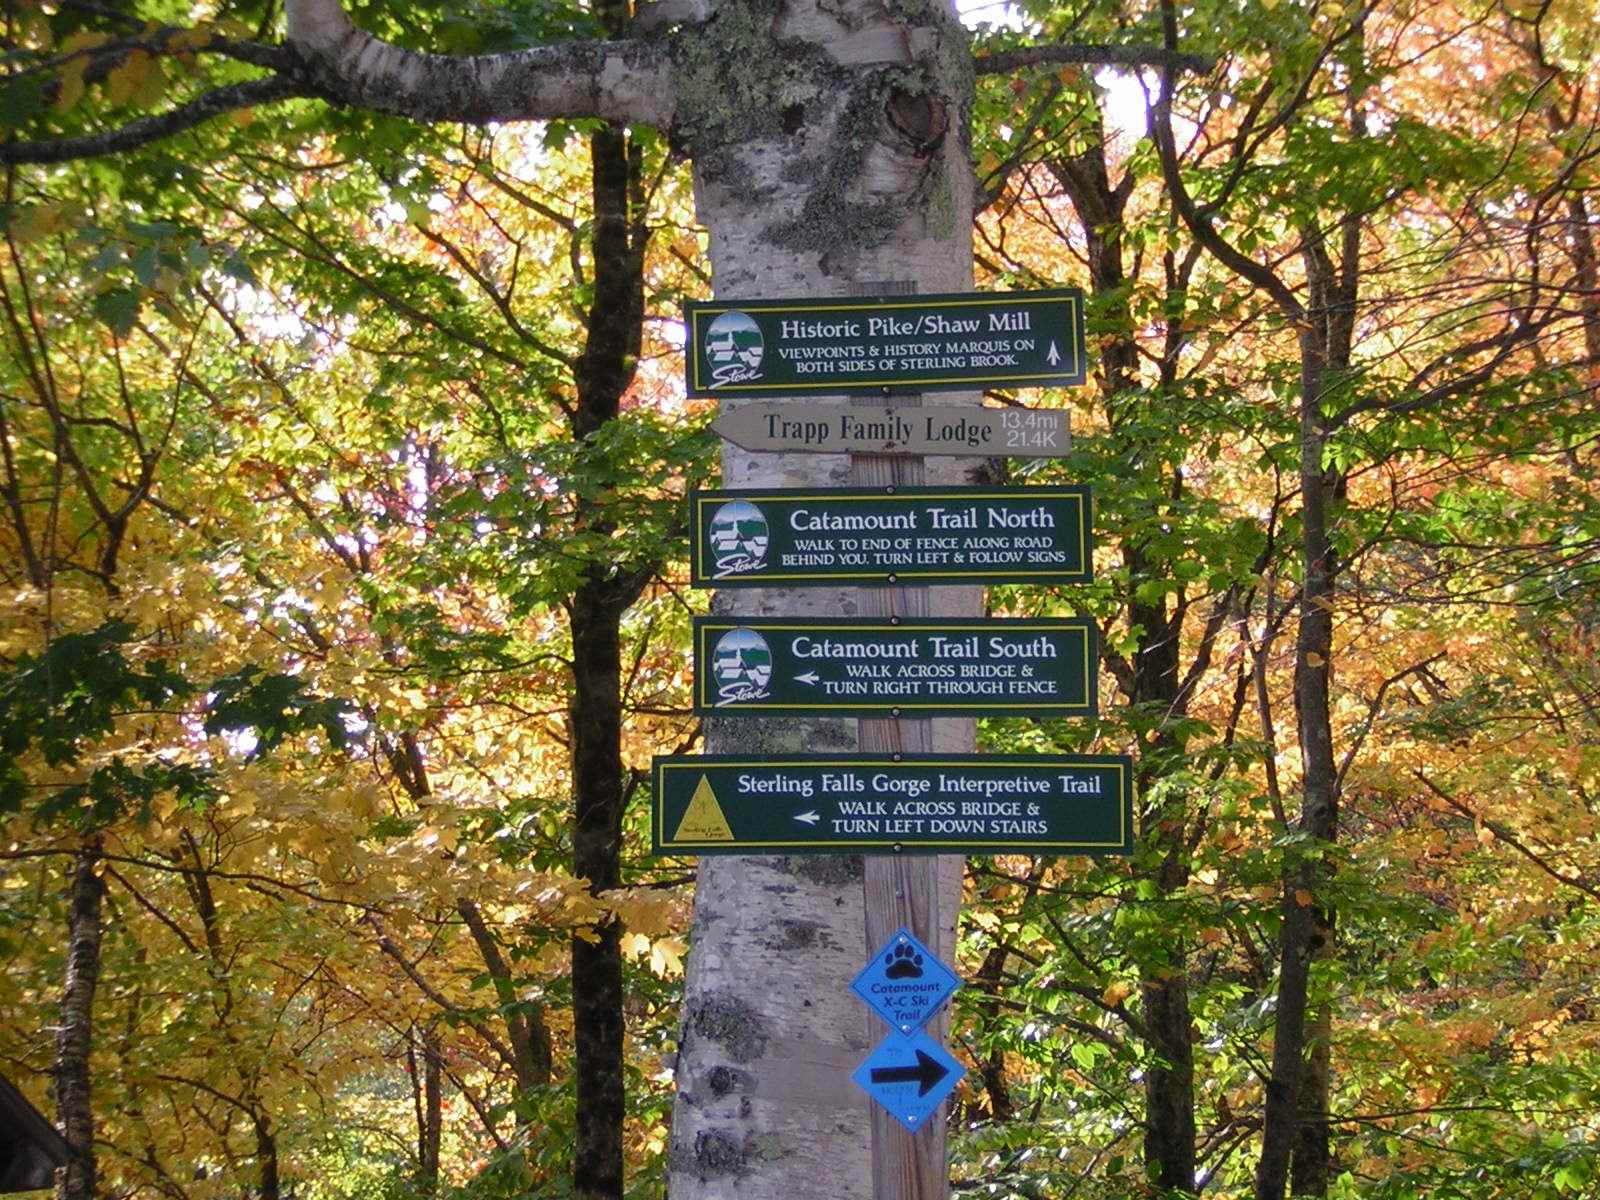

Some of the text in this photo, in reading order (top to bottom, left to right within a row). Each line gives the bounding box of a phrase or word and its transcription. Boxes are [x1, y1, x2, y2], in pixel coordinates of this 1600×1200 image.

[781, 312, 1030, 339] Historic Pike/Shaw Mill
[779, 339, 1036, 359] VIEWPOINTS & HISTORY MARQUIS ON
[796, 361, 834, 373] BOTH
[839, 360, 875, 371] SIDES
[879, 359, 895, 370] OF
[901, 357, 966, 369] STERLING
[1001, 412, 1058, 429] 13.4mi
[764, 414, 992, 447] Trapp Family Lodge
[1007, 431, 1056, 447] 21.4K
[790, 507, 1054, 531] Catamount Trail North
[795, 537, 1052, 551] WALK TO END OF FENCE ALONG ROAD
[782, 551, 1065, 566] BEHIND YOU. TURN LEFT & FOLLOW SIGNS
[792, 636, 1056, 658] Catamount Trail South
[846, 665, 1034, 677] WALK ACROSS BRIDGE &
[822, 681, 1057, 694] TURN RIGHT THROUGH FENCE
[738, 774, 1101, 797] Sterling Falls Gorge Interpretive Trail
[839, 802, 1040, 816] WALK ACROSS BRIDGE &
[831, 820, 1047, 833] TURN LEFT DOWN STAIRS
[871, 983, 940, 993] Catamount
[884, 995, 929, 1007] X-C Ski
[894, 1010, 920, 1021] Trail
